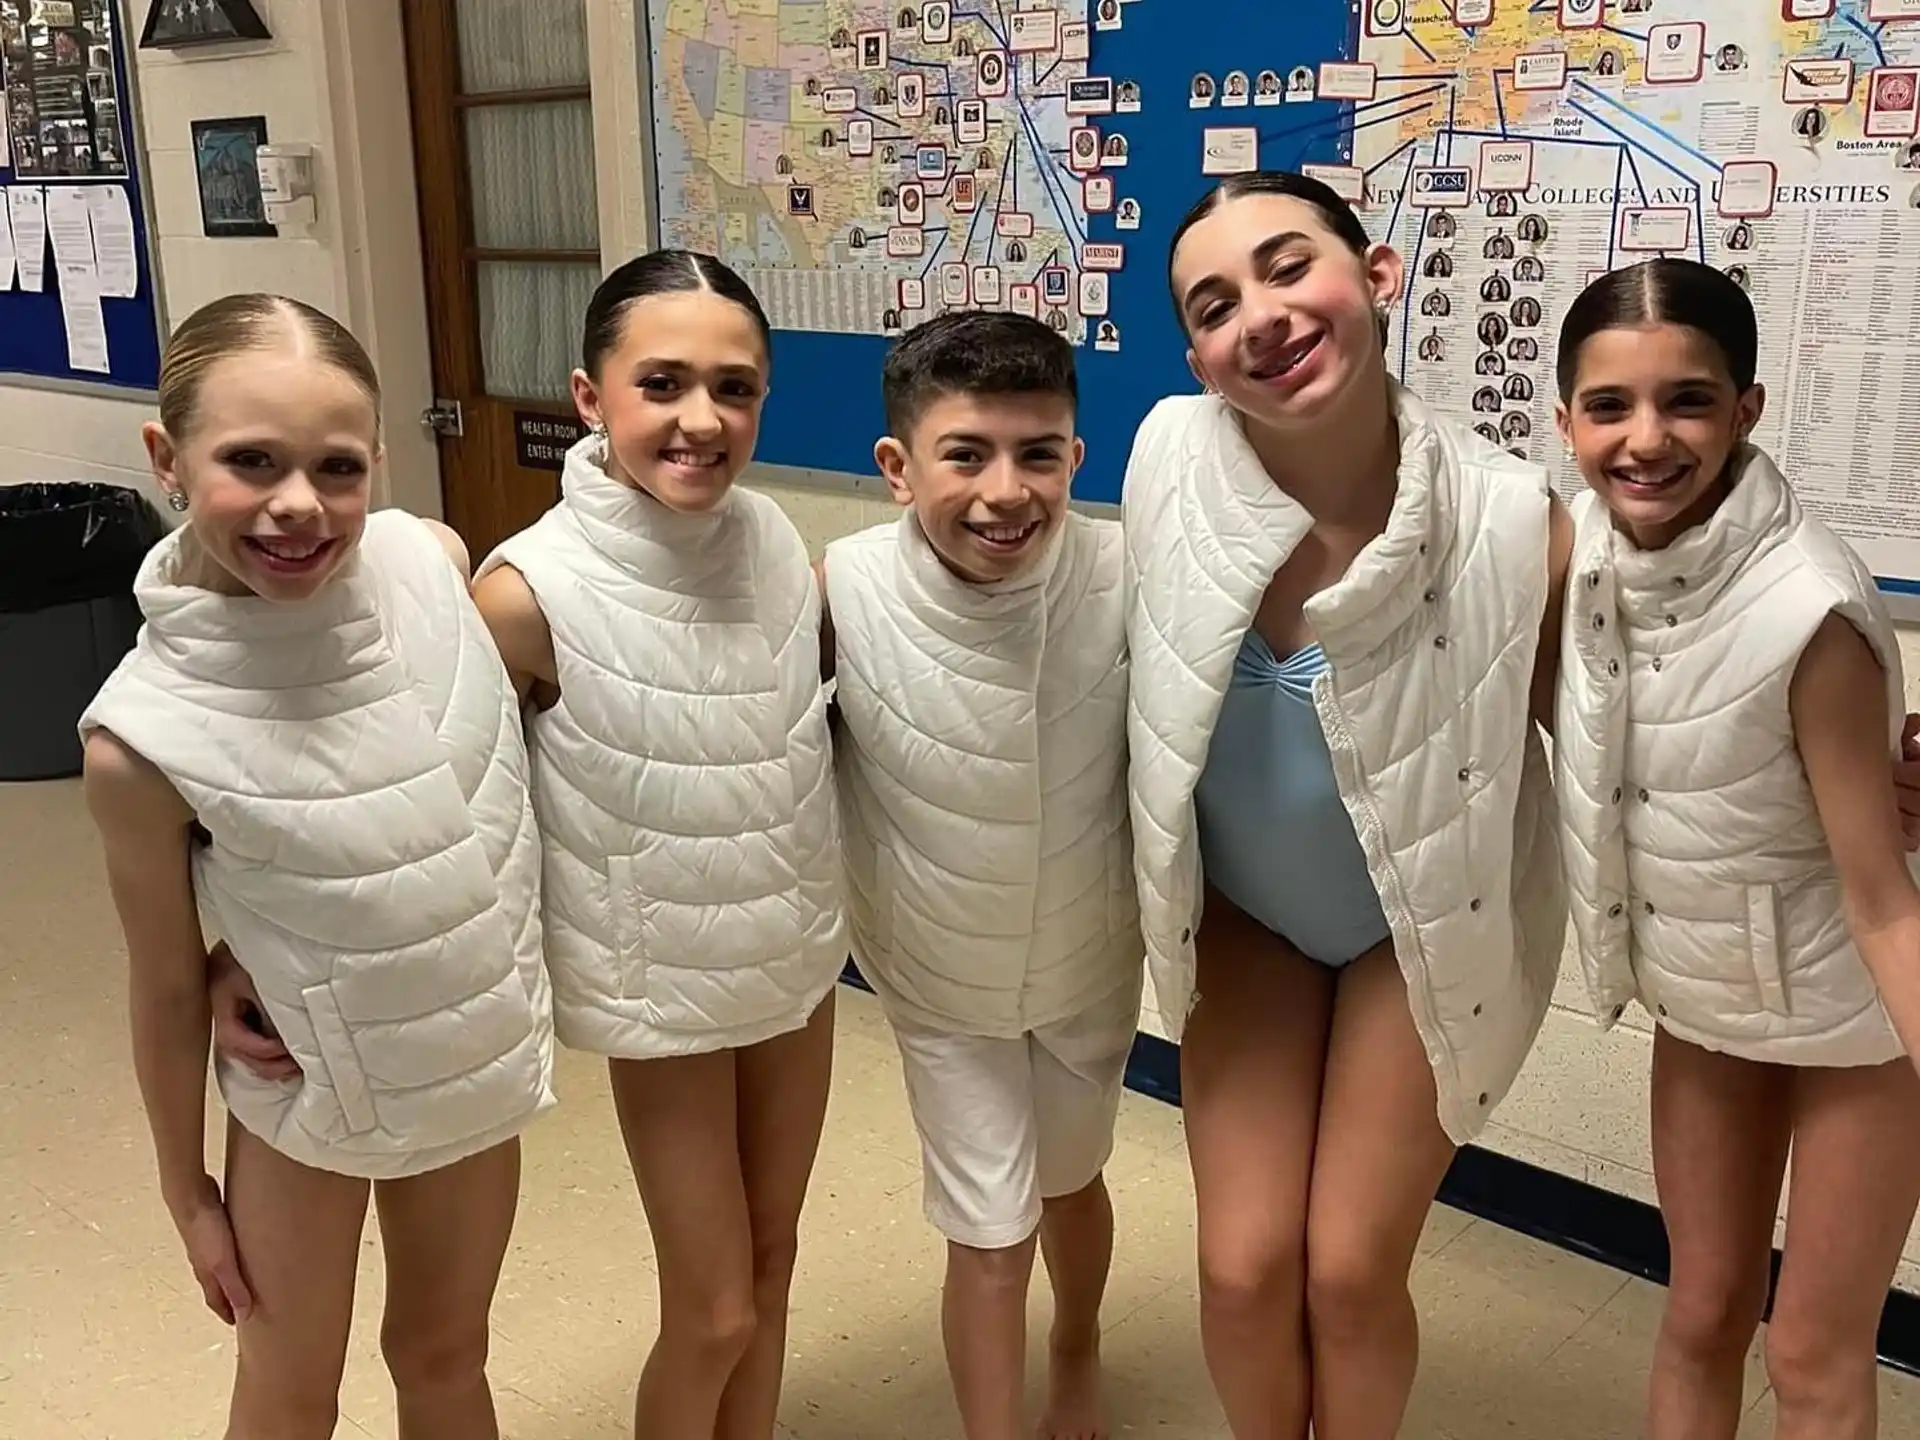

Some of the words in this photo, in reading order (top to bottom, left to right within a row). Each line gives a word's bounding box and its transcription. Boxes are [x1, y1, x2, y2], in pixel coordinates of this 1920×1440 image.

[1553, 116, 1583, 126] Rhode
[1554, 127, 1581, 136] Island
[1836, 140, 1873, 149] Boston
[1876, 139, 1902, 149] Area
[1490, 153, 1522, 163] UCONN
[1434, 174, 1466, 187] CCSU
[1522, 183, 1642, 204] COLLEGES
[1650, 187, 1698, 204] AND
[522, 420, 552, 437] HEALTH
[554, 424, 577, 439] ROOM
[527, 444, 553, 460] ENTER
